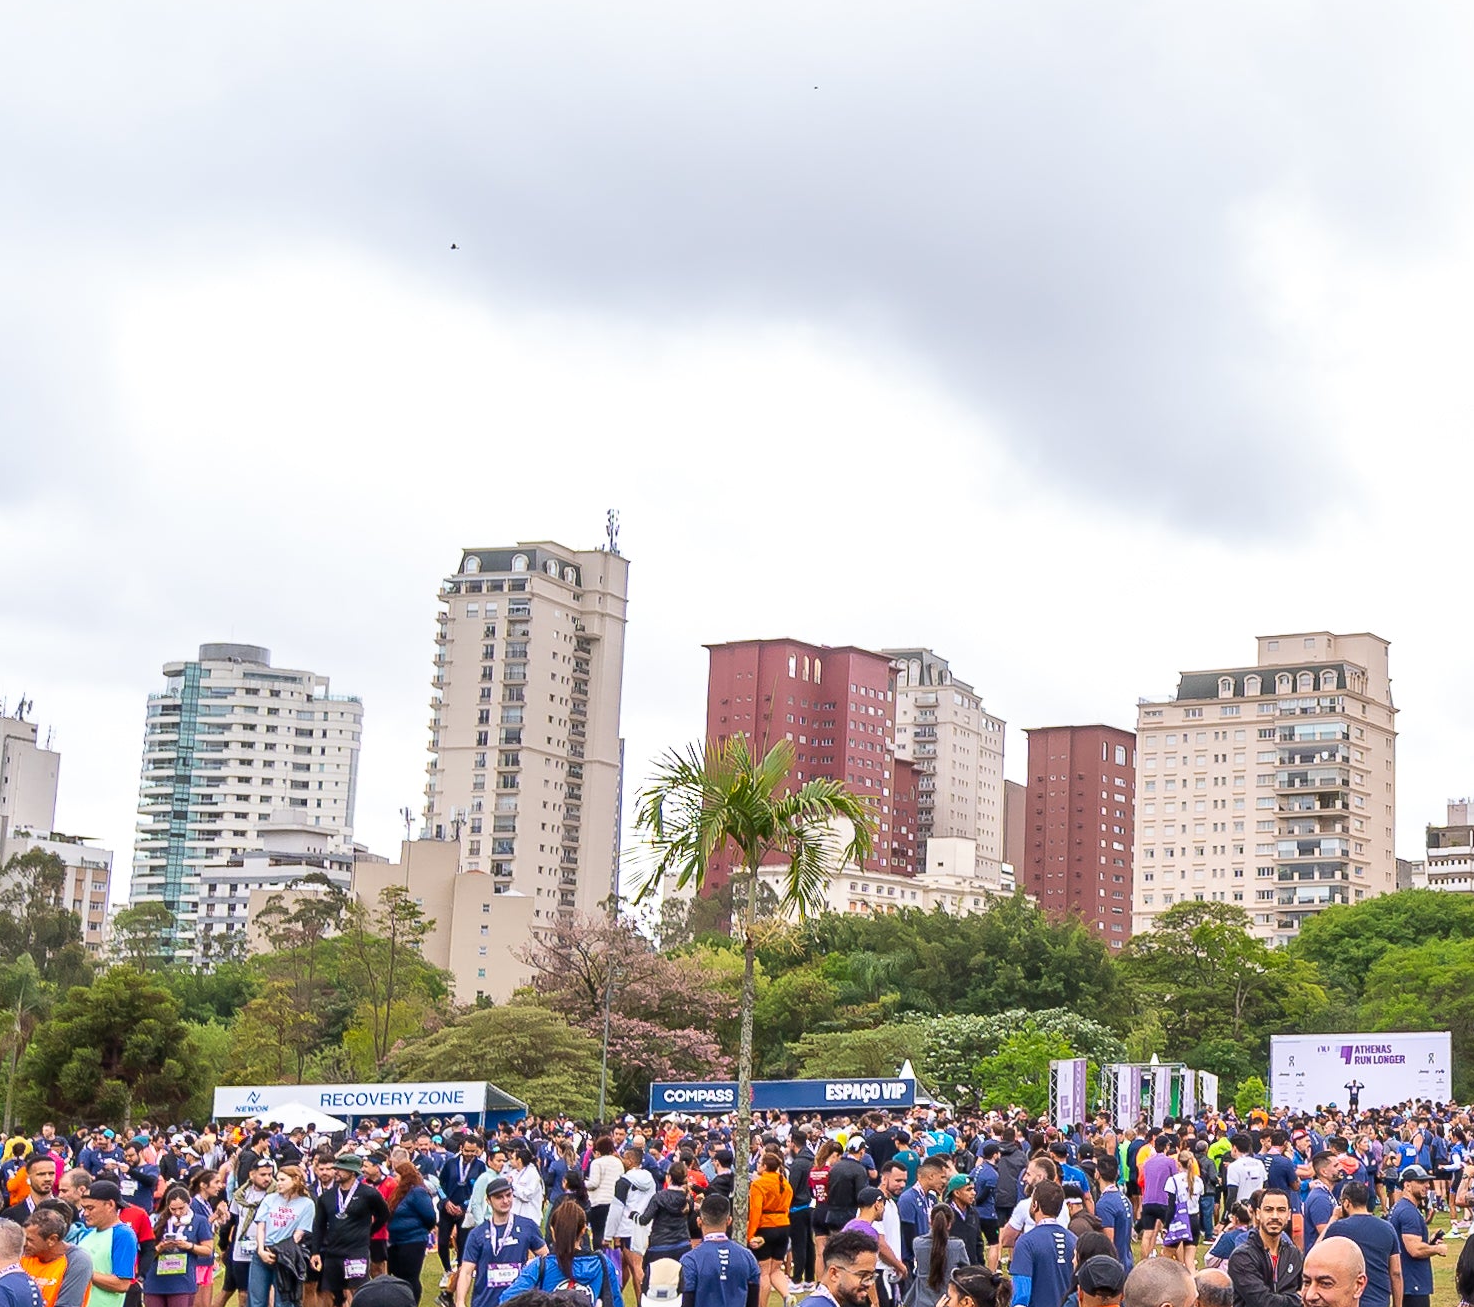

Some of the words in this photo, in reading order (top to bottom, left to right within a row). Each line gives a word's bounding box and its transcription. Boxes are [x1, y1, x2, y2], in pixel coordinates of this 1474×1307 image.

[1354, 1044, 1392, 1054] ATHENAS
[1354, 1055, 1372, 1065] RUN
[1373, 1054, 1406, 1064] LONGER
[320, 1091, 415, 1107] RECOVERY
[417, 1090, 465, 1105] ZONE
[663, 1088, 734, 1103] COMPASS
[825, 1083, 881, 1103] ESPAÇO
[882, 1082, 908, 1100] VIP
